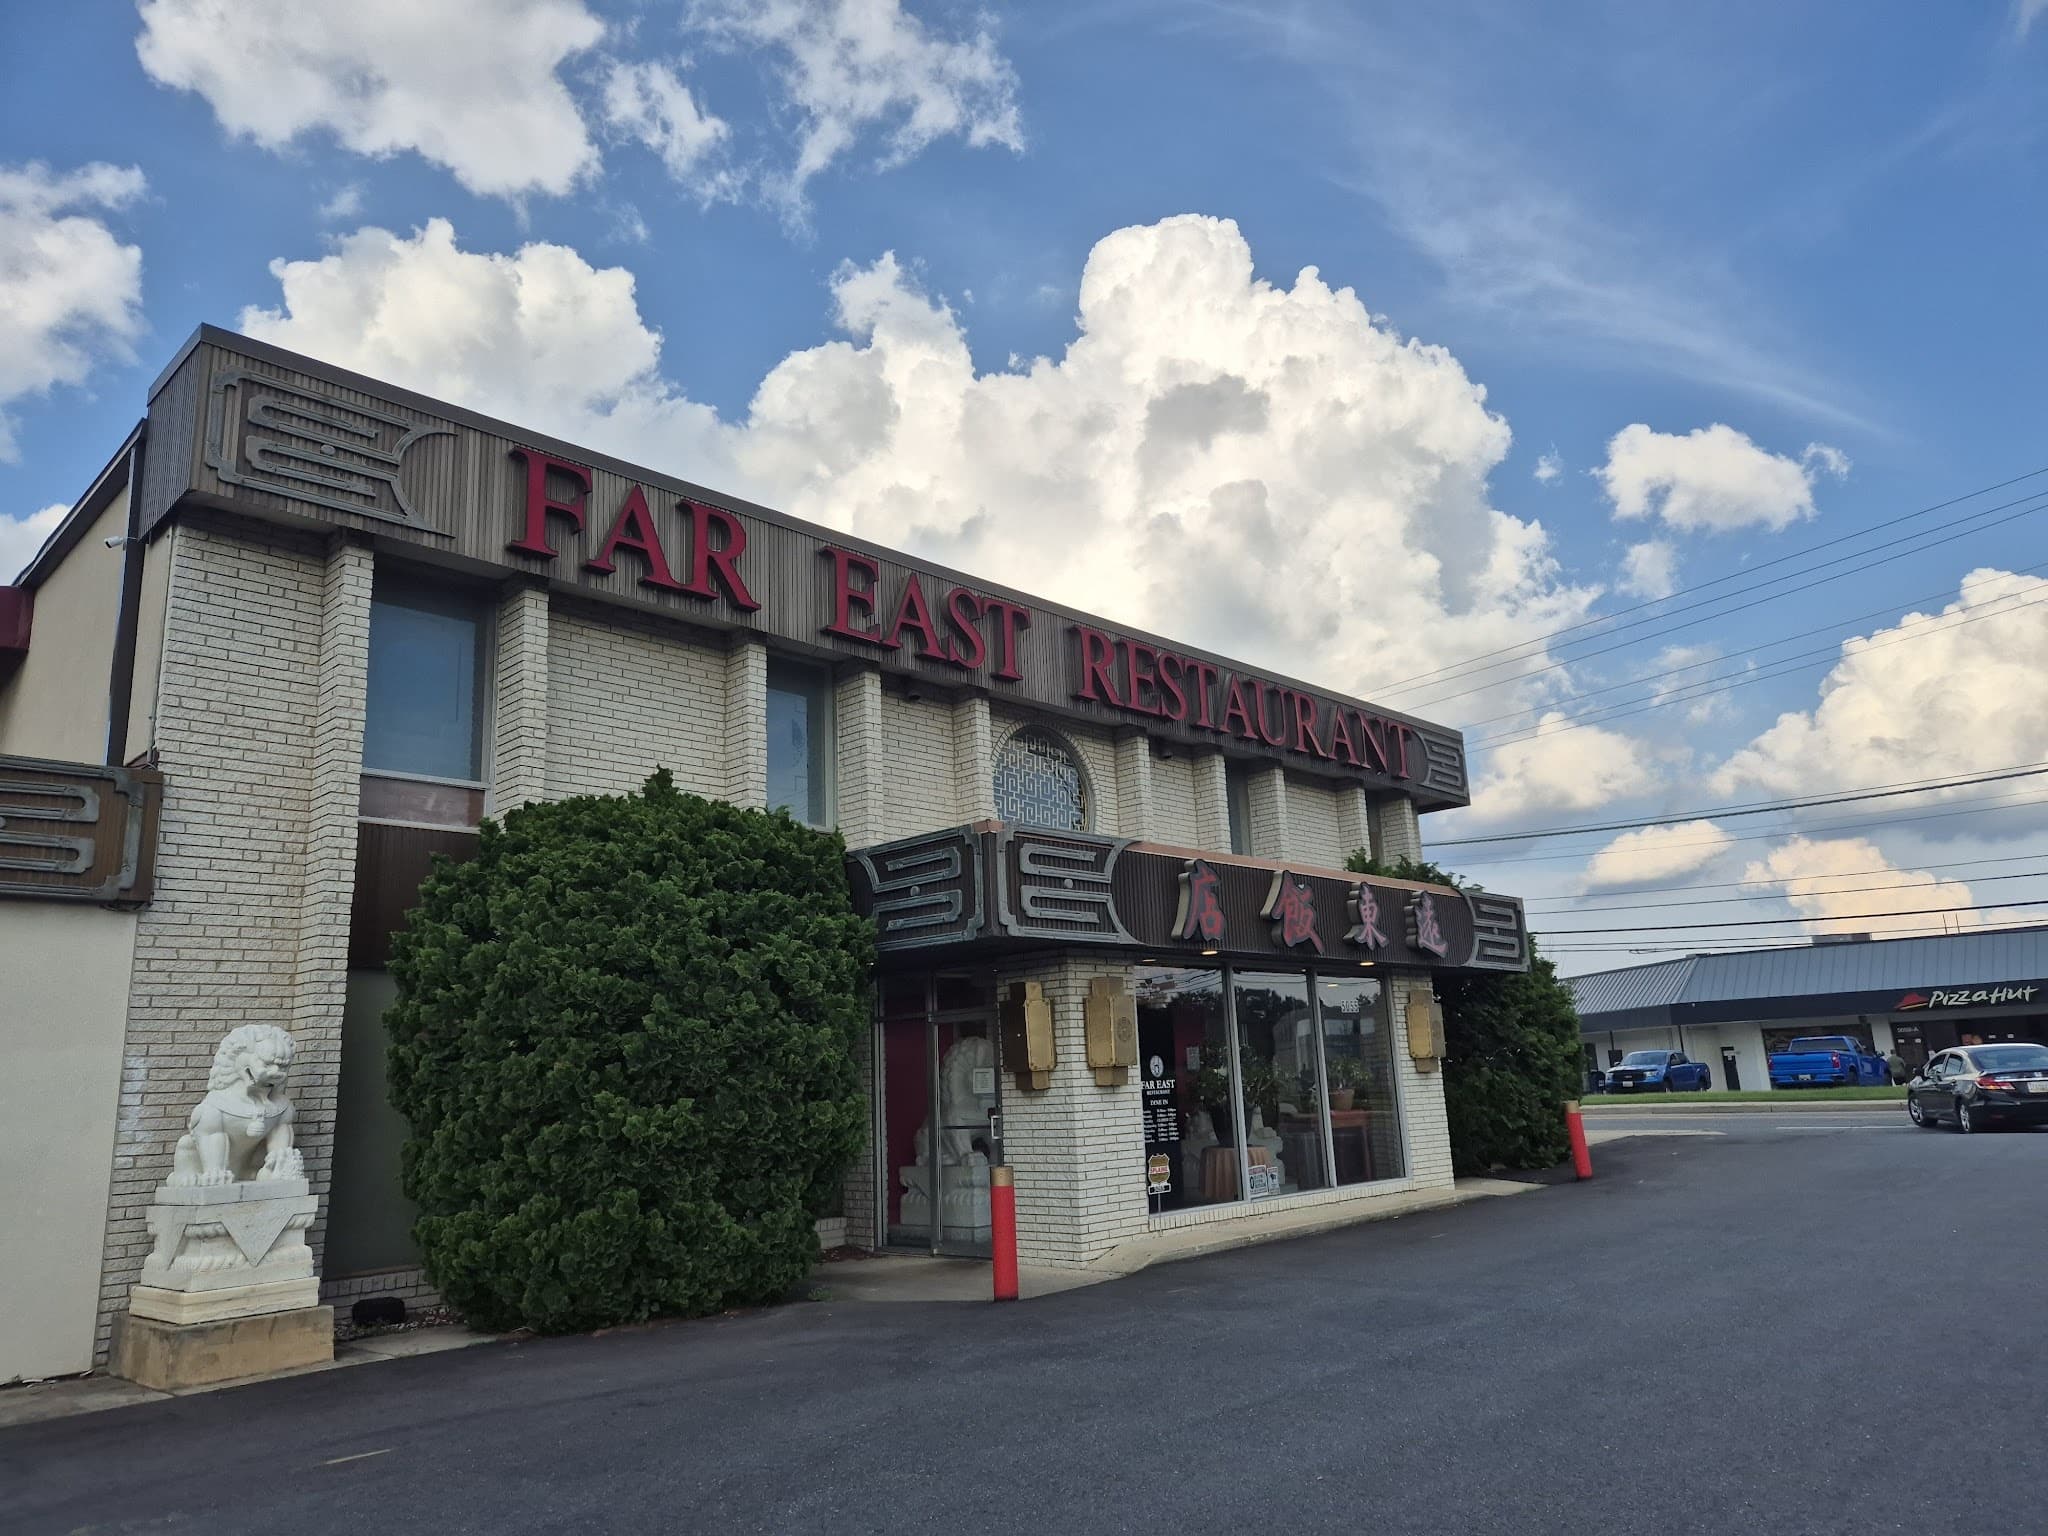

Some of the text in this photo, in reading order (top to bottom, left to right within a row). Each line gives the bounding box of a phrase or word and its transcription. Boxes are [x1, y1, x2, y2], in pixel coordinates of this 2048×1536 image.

[506, 446, 1414, 780] FAR EAST RESTAURANT
[1156, 1079, 1175, 1089] EAST
